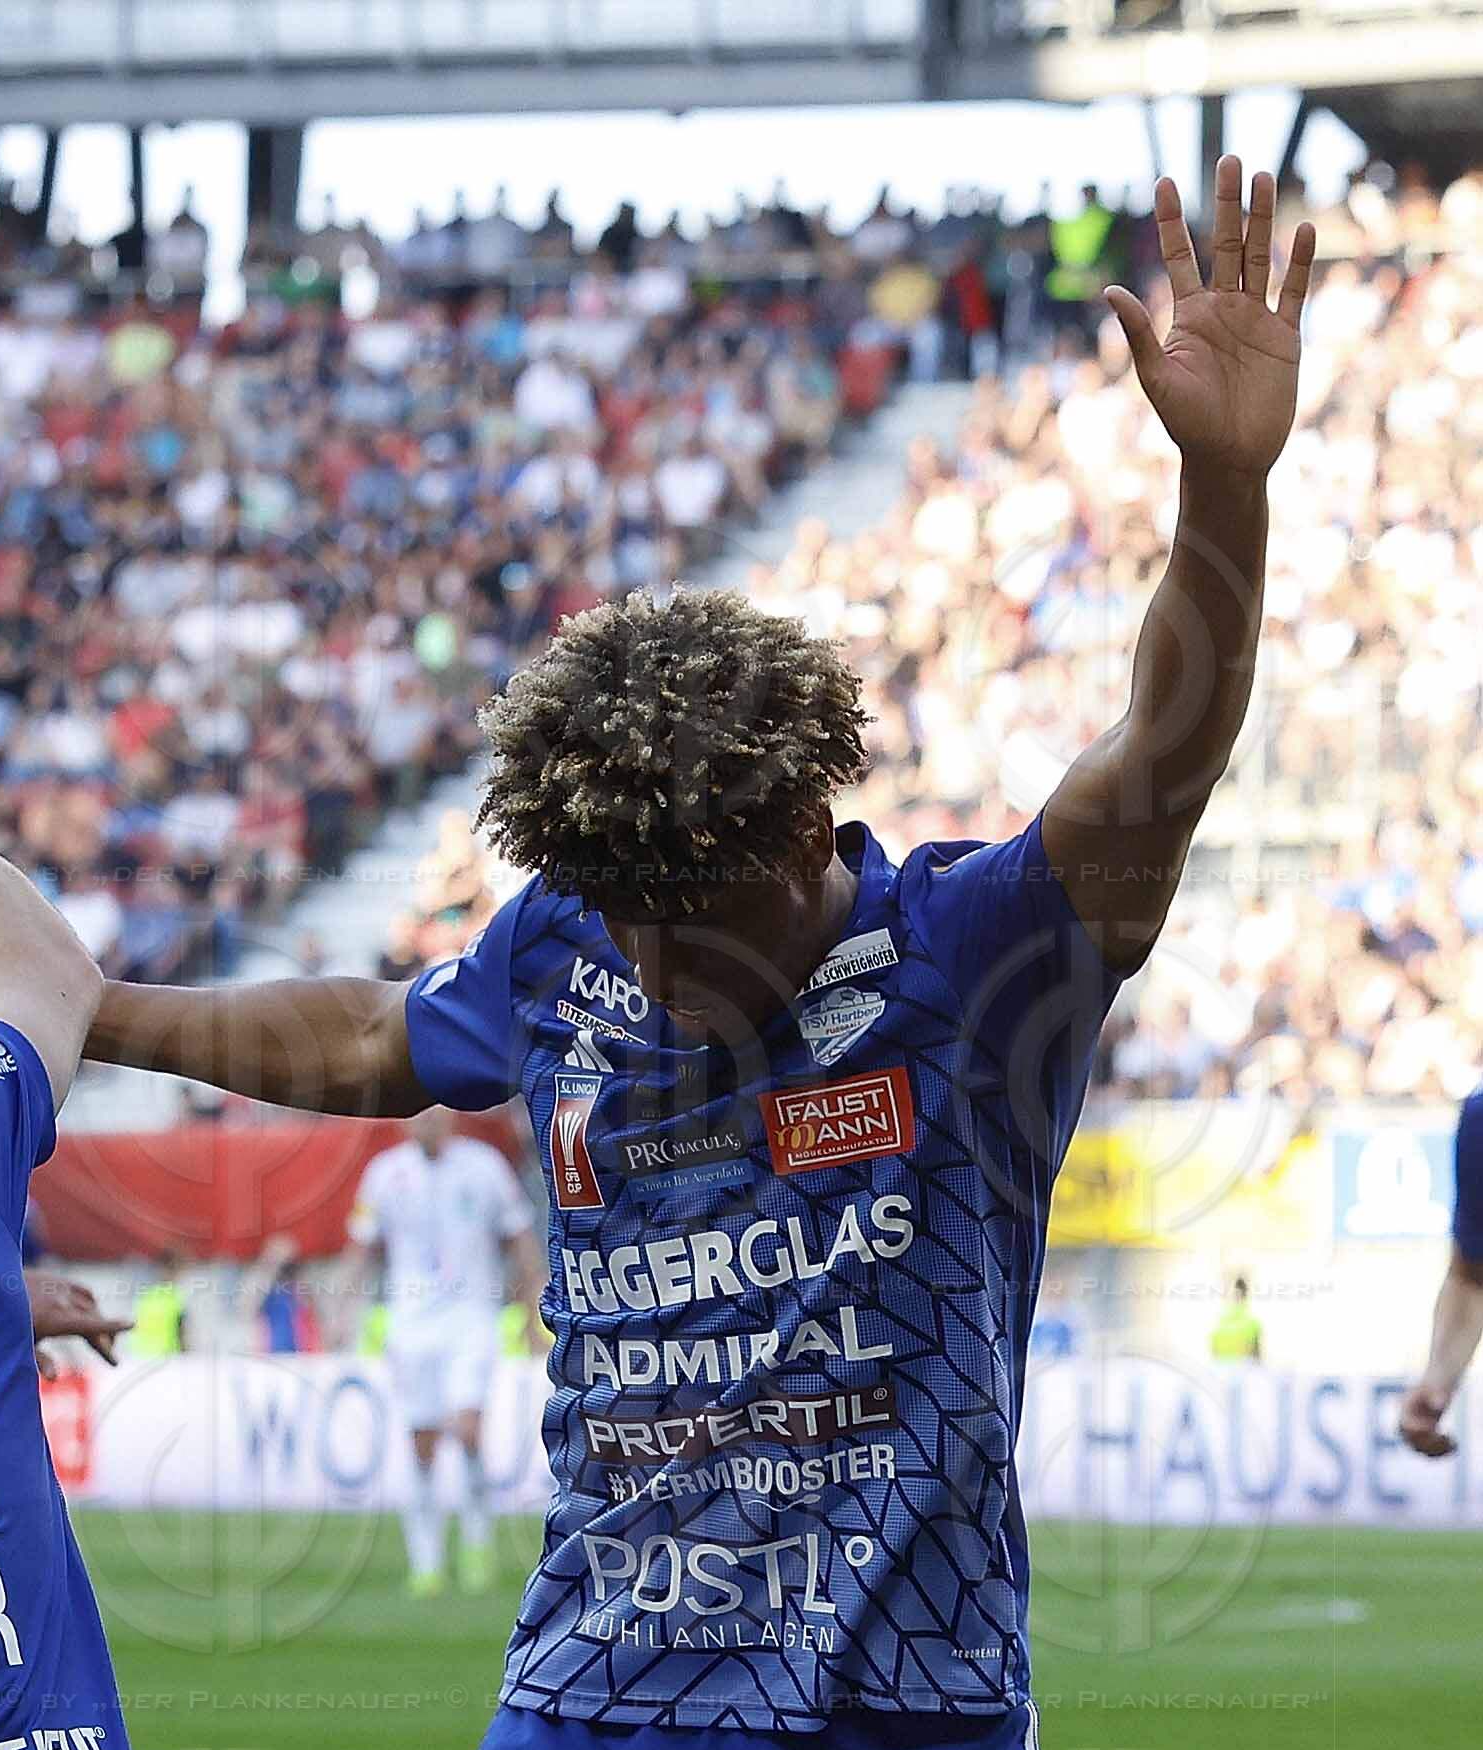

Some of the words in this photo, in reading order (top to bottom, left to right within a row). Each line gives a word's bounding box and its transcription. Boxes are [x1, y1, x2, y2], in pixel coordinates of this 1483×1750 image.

[569, 956, 649, 1023] KAPO
[824, 949, 898, 983] SCHWEIGHOFER
[802, 1016, 828, 1031] TSV
[785, 1088, 885, 1125] FAUST
[562, 1194, 914, 1314] EGGERGLAS
[583, 1305, 894, 1391] ADMIRAL
